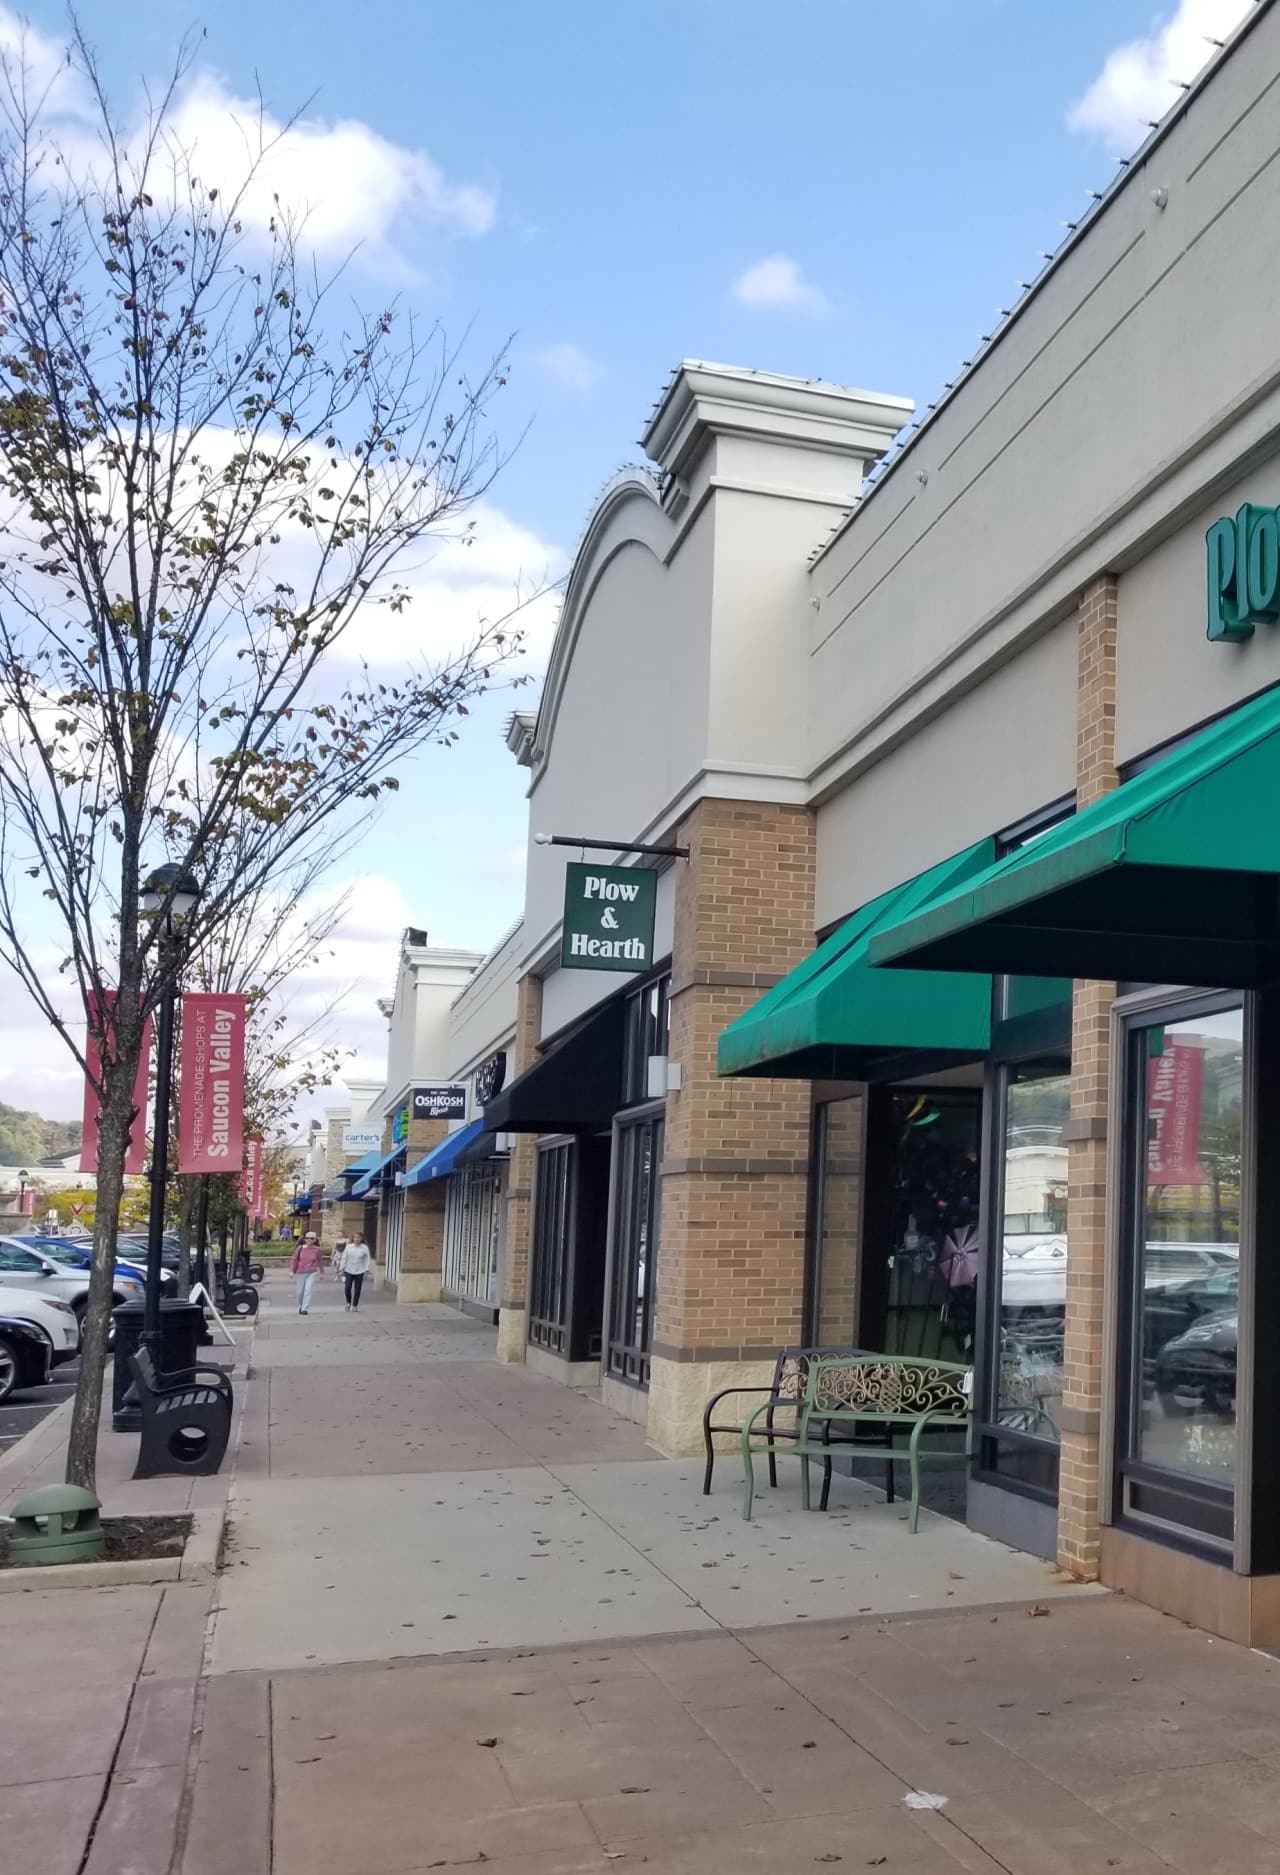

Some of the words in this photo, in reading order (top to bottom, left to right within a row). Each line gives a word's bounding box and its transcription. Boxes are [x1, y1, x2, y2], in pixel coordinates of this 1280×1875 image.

[583, 876, 640, 902] Plow
[600, 906, 619, 929] &
[570, 933, 646, 960] Hearth
[196, 1009, 207, 1024] AT
[195, 1024, 206, 1063] SHOPS
[209, 1008, 236, 1074] Valley
[194, 1066, 205, 1134] PROMENADE
[207, 1080, 231, 1158] Saucon
[193, 1136, 204, 1160] THE
[345, 1133, 380, 1141] carter's
